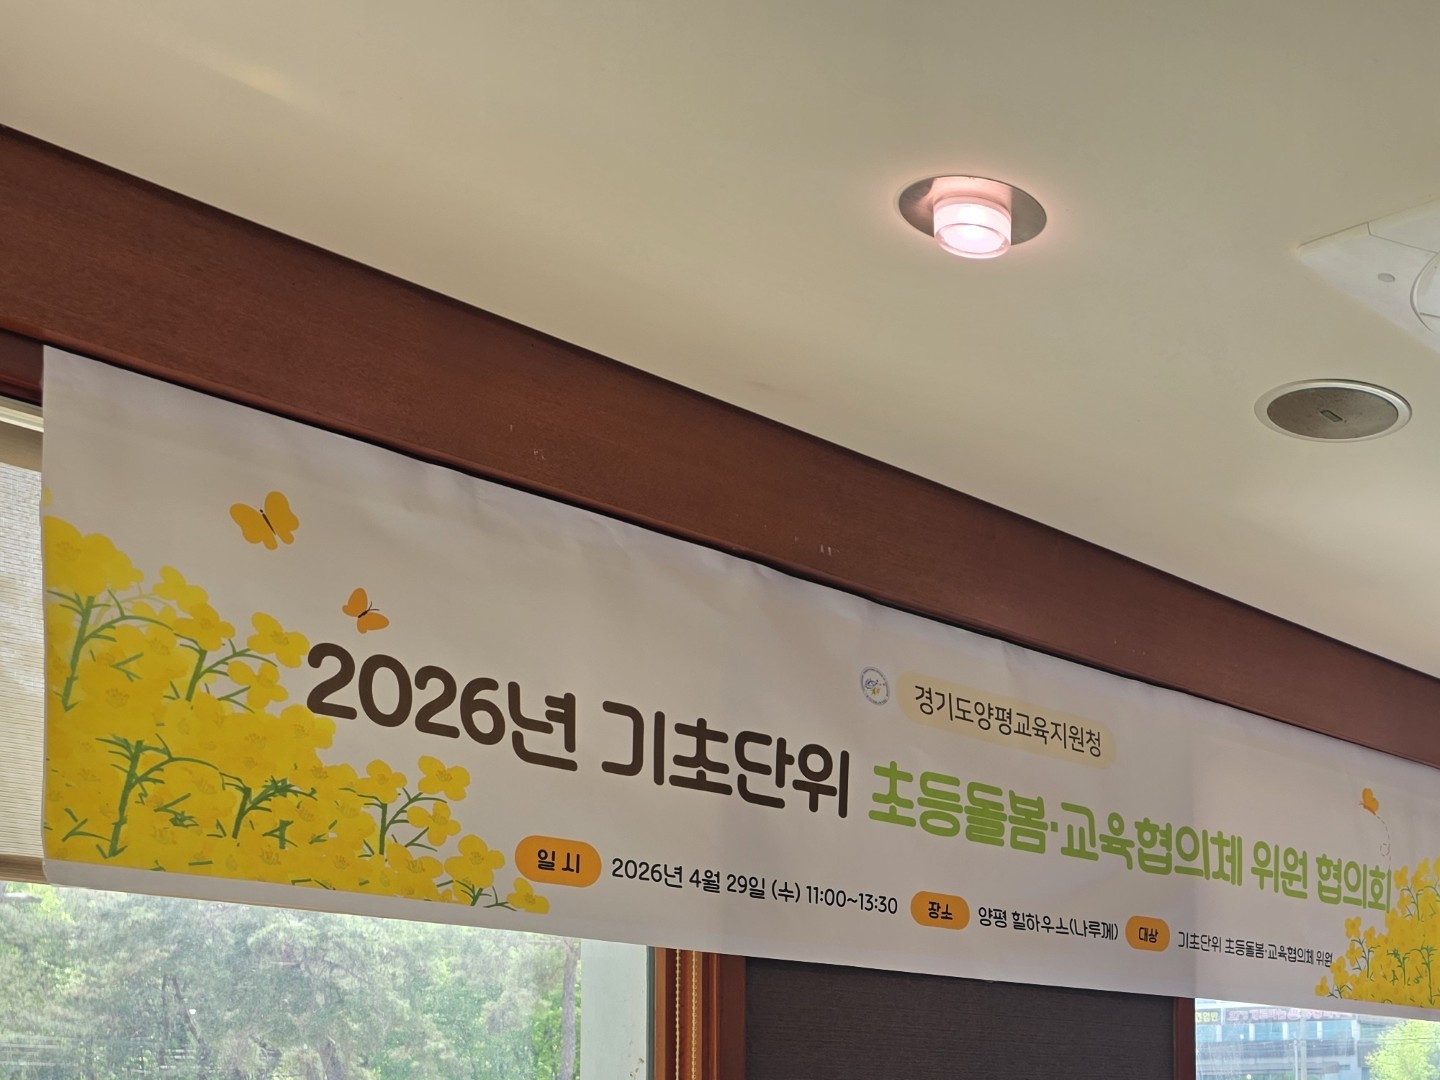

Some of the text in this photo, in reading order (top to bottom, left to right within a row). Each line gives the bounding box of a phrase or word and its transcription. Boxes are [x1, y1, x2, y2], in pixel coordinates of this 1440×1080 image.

[914, 684, 1103, 758] 경기도양평교육지원청
[306, 641, 578, 772] 2026년
[600, 700, 850, 818] 기초단위
[1250, 840, 1308, 898] 위원
[1315, 855, 1392, 915] 협의회
[611, 857, 899, 915] 2026년 4월 29일 (수) 11:00~13:30
[927, 901, 954, 921] 장소
[977, 906, 1008, 930] 양평
[1137, 925, 1159, 944] 대상
[1177, 929, 1222, 954] 기초단위
[1315, 951, 1334, 969] 위원
